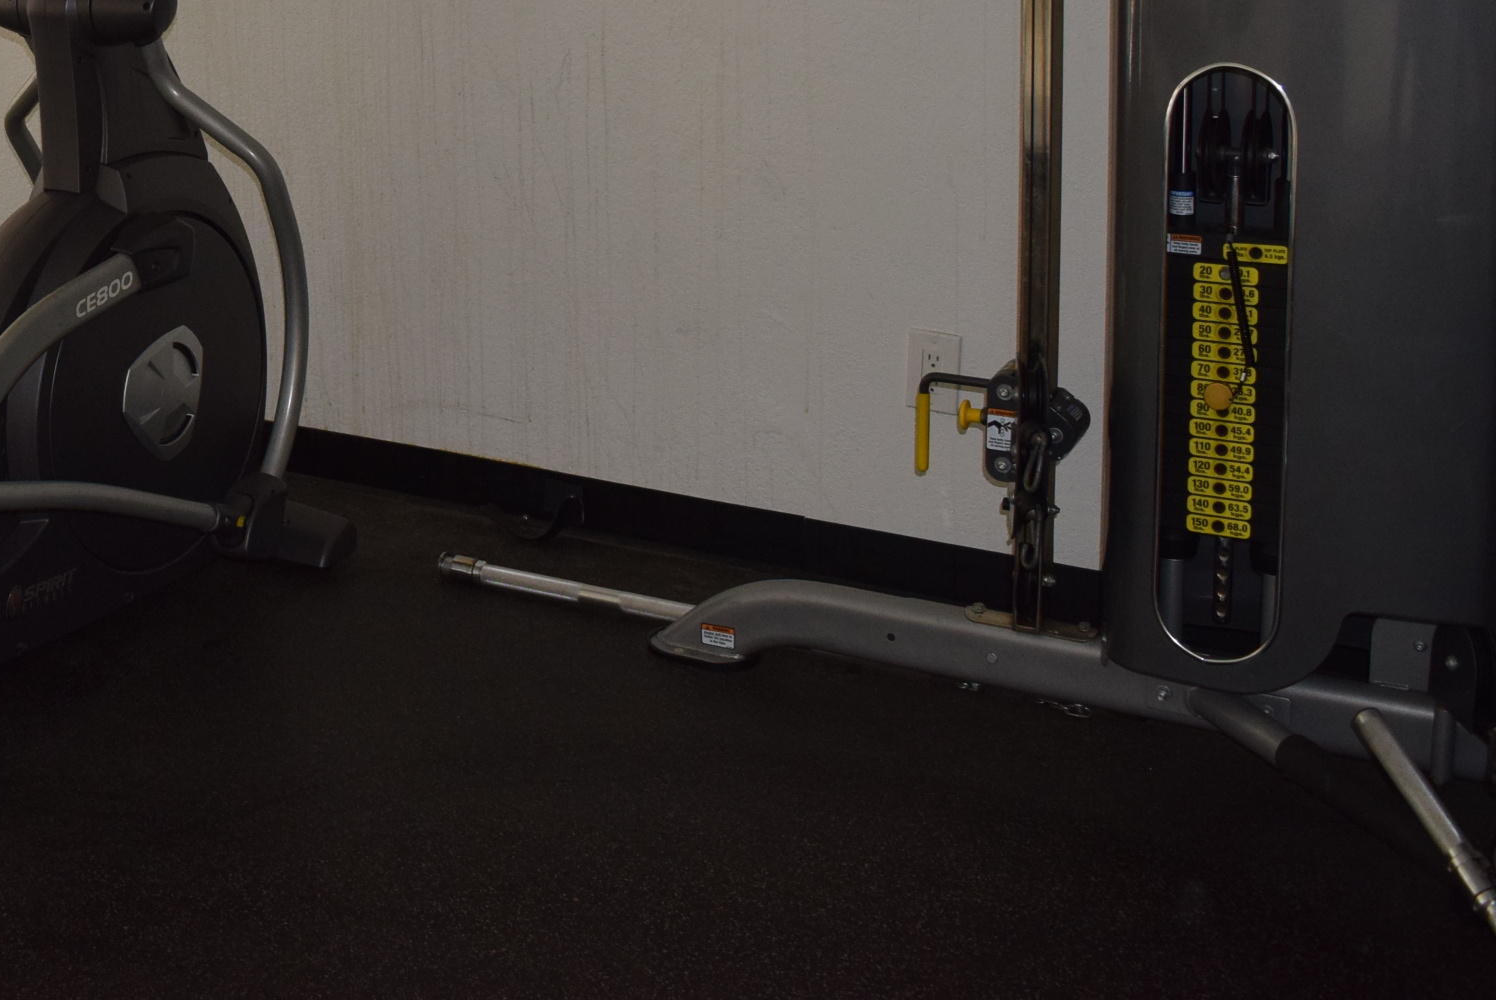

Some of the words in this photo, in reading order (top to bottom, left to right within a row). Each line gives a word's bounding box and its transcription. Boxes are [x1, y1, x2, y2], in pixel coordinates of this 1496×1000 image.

[1199, 265, 1212, 275] 20
[75, 271, 133, 318] CE800
[1199, 285, 1212, 295] 30
[1198, 305, 1211, 315] 40
[1198, 324, 1211, 334] 50
[1198, 343, 1211, 353] 60
[1197, 363, 1210, 373] 70
[1196, 402, 1209, 412] 90
[1232, 407, 1252, 417] 40.8
[1194, 421, 1211, 431] 100
[1231, 426, 1251, 436] 45.4
[1194, 440, 1211, 451] 110
[1231, 445, 1251, 455] 49.9
[1193, 460, 1210, 470] 120
[1229, 464, 1250, 474] 54.4
[1192, 479, 1209, 489] 130
[1229, 484, 1249, 494] 59.0
[1192, 498, 1209, 509] 140
[1228, 503, 1249, 514] 63.5
[1191, 517, 1208, 528] 150
[1227, 522, 1248, 532] 68.0
